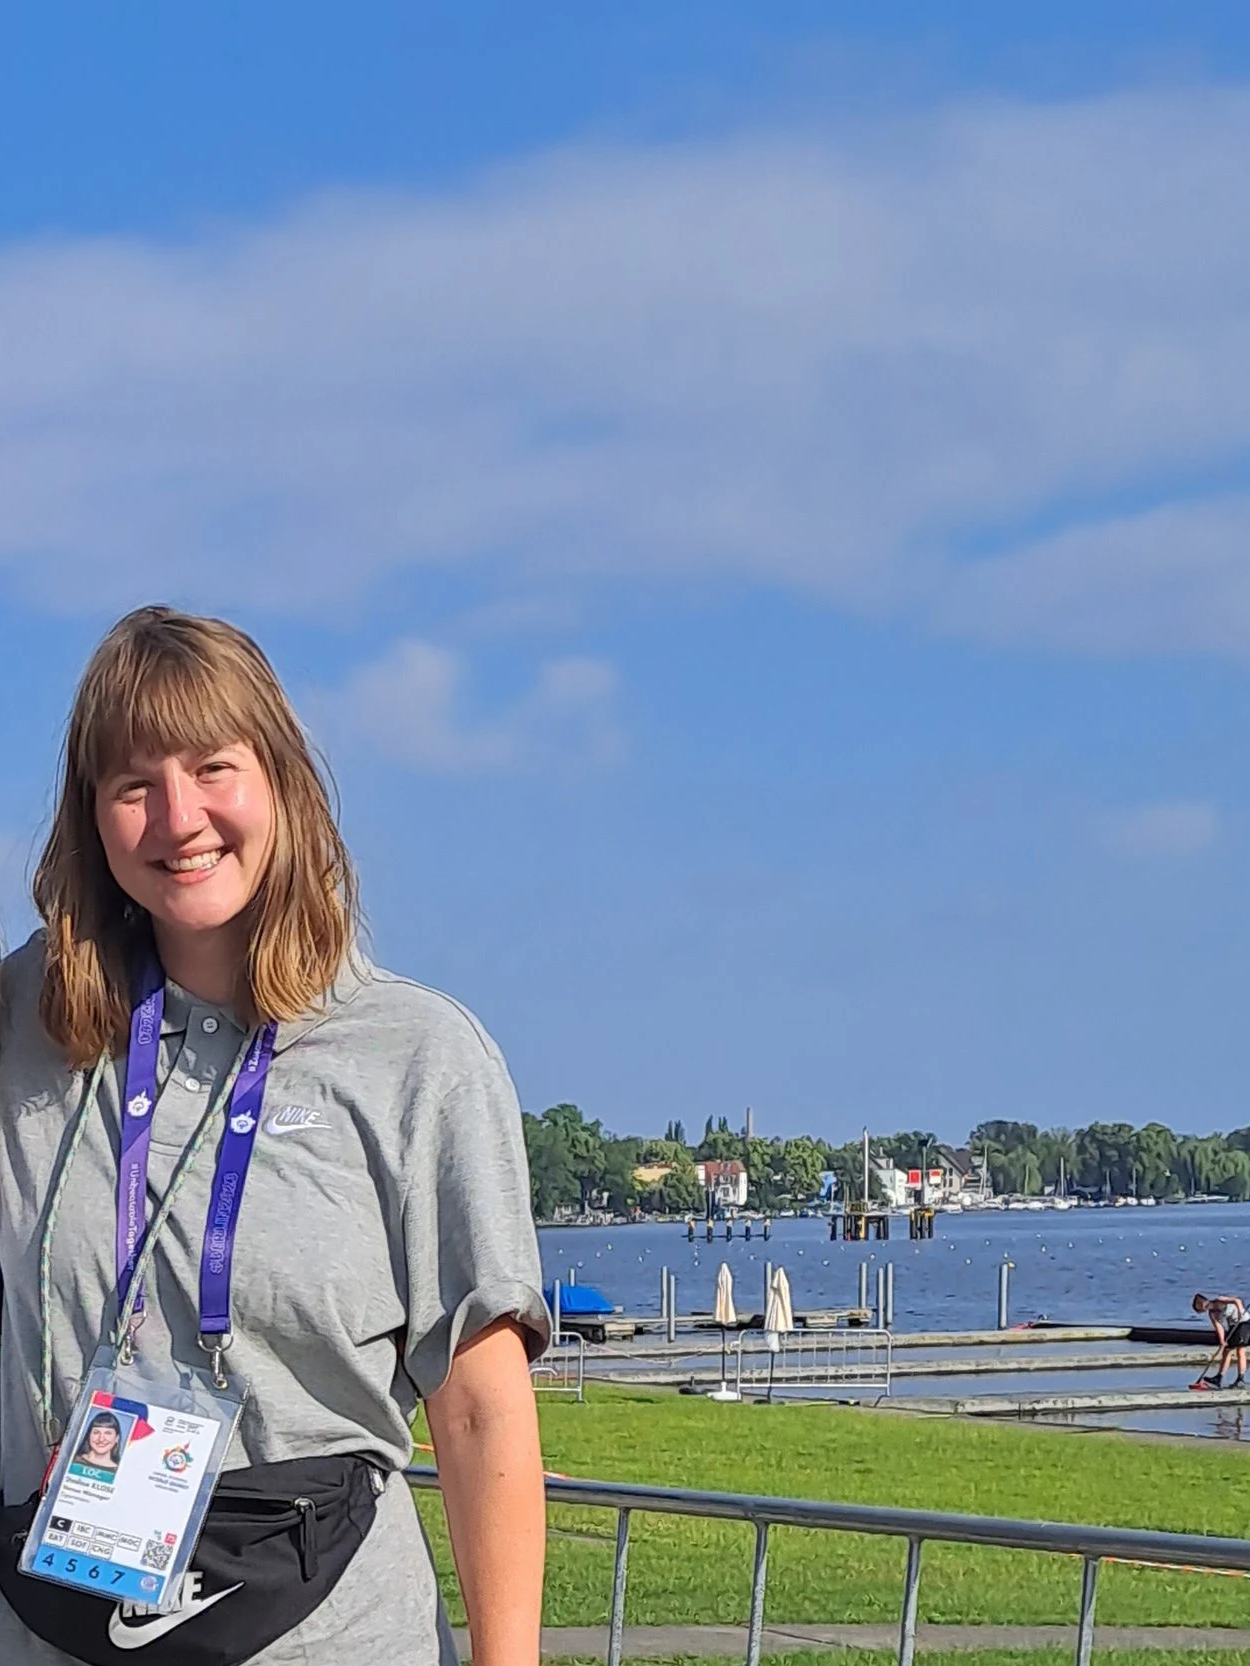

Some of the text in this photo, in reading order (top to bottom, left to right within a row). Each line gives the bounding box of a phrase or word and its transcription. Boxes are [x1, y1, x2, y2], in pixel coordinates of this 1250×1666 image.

[279, 1105, 321, 1125] NIKE
[42, 1553, 125, 1585] 4 5 6 7
